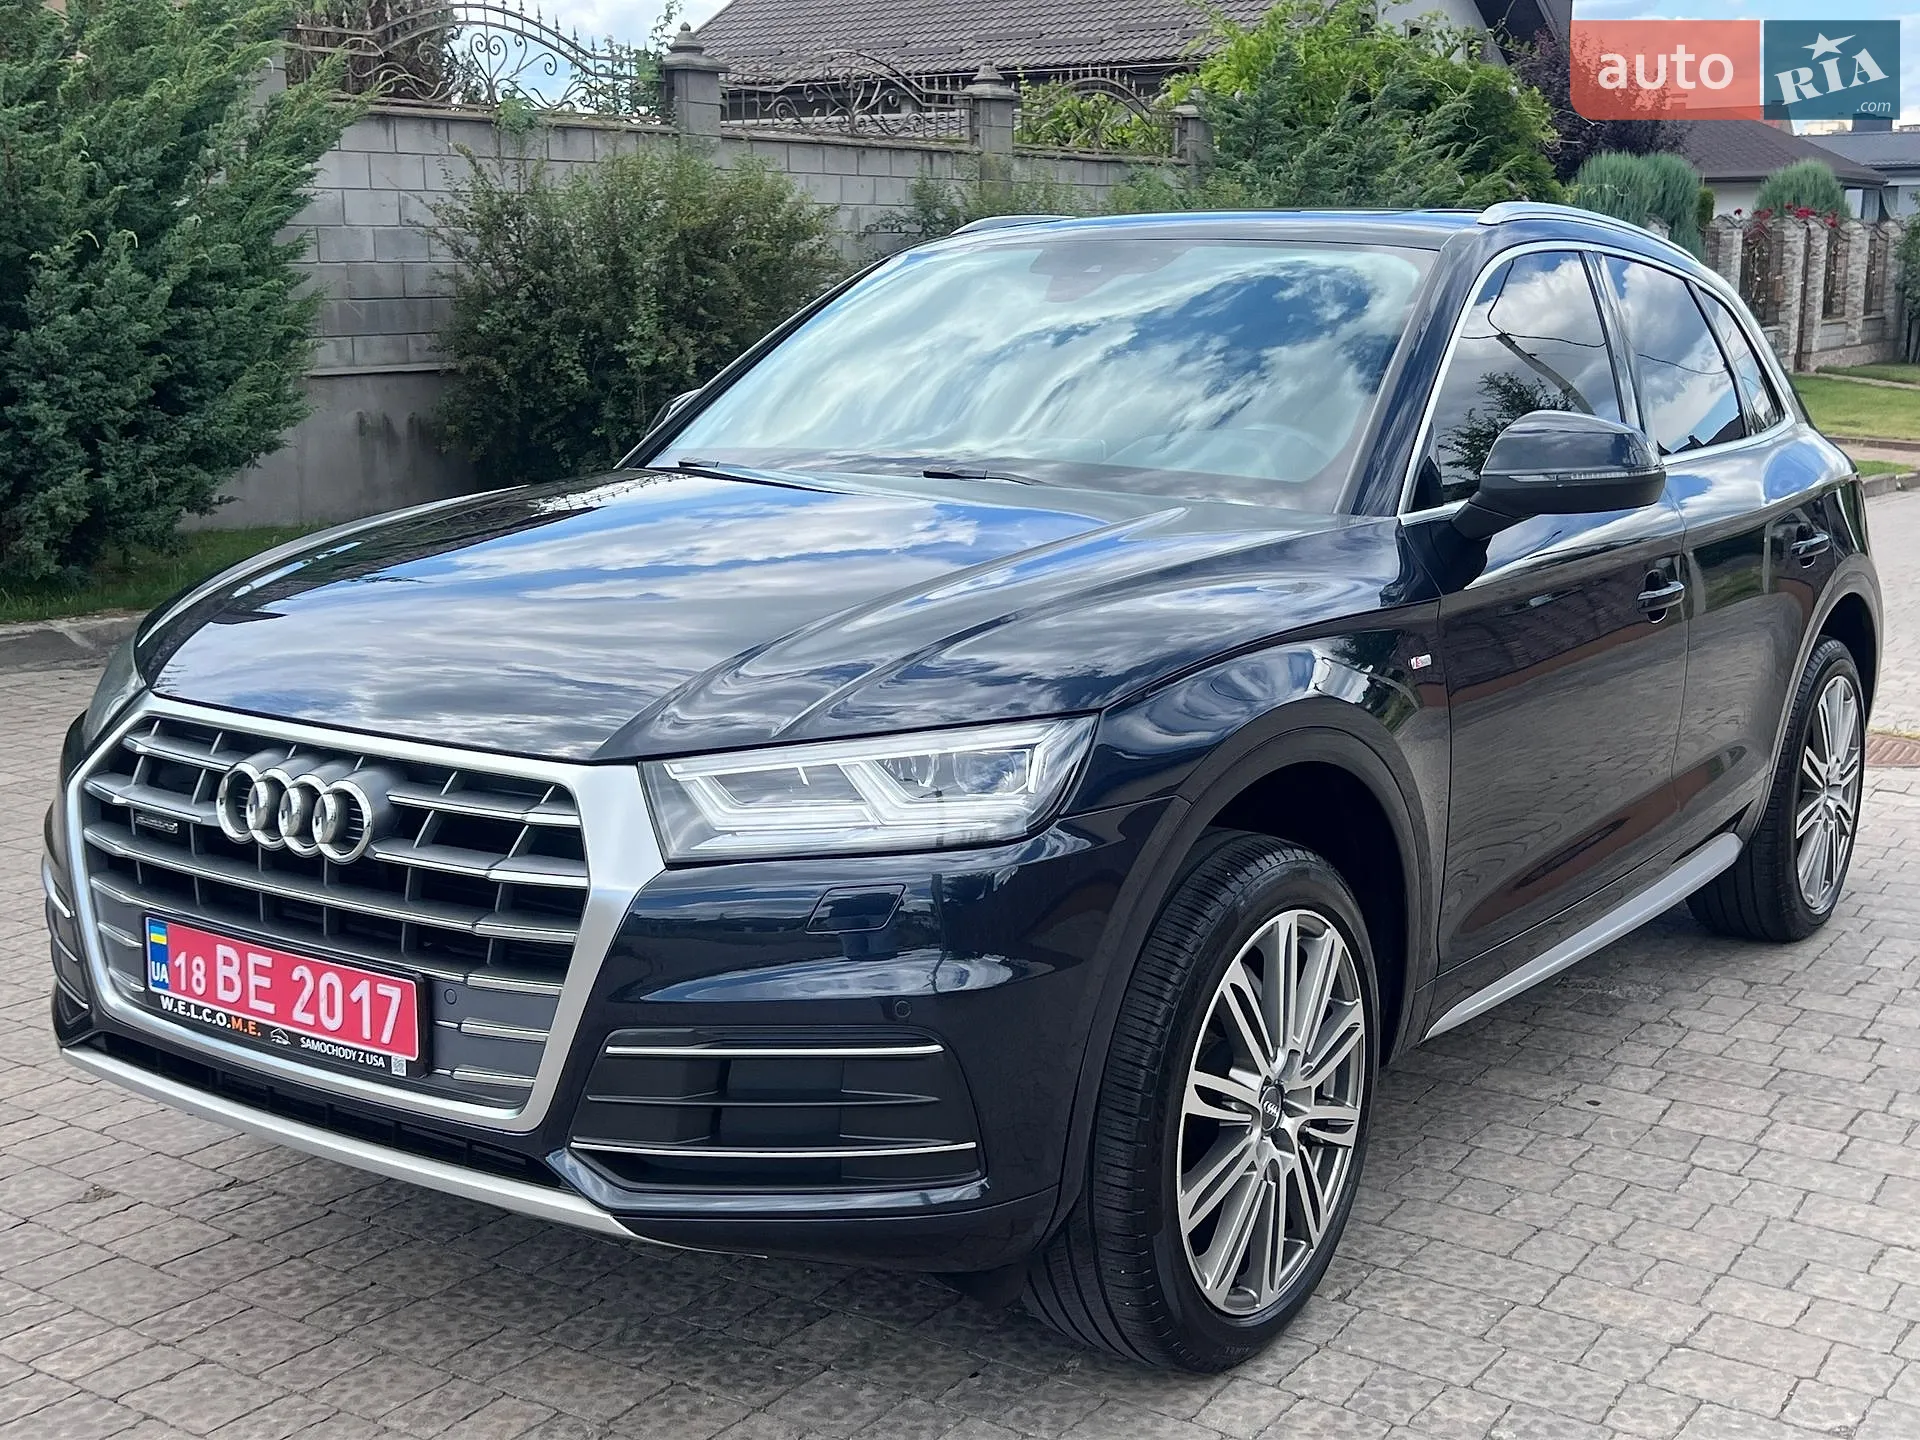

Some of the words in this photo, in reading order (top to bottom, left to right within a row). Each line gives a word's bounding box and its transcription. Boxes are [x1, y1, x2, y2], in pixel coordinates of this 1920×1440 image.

[151, 961, 169, 984] UA
[174, 952, 206, 996] 18
[215, 944, 275, 1014] BE
[291, 966, 401, 1044] 2017
[300, 1037, 357, 1061] SAMOCHODY
[357, 1051, 365, 1063] Z
[366, 1054, 385, 1068] USA
